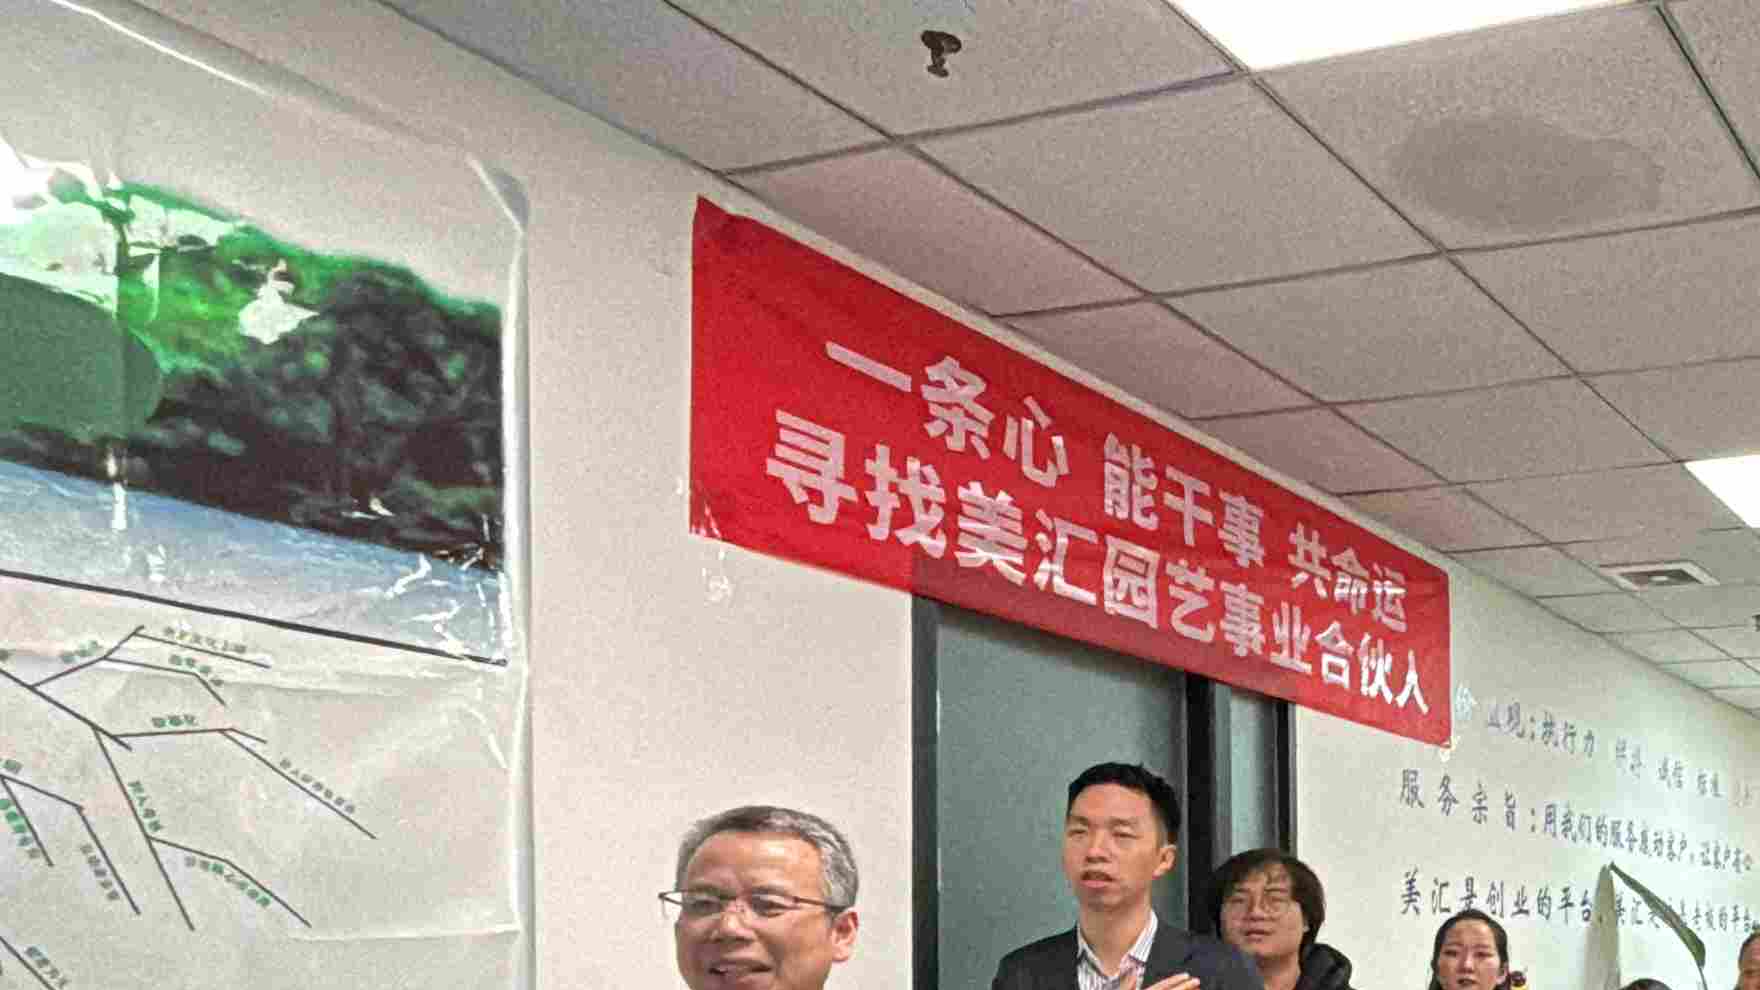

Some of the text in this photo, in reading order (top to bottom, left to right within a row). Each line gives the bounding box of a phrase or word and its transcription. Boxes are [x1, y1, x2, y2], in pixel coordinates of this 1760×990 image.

[764, 409, 1430, 715] 寻找美汇园艺事业合伙人
[825, 340, 1408, 633] 一条心 能干事 共命运
